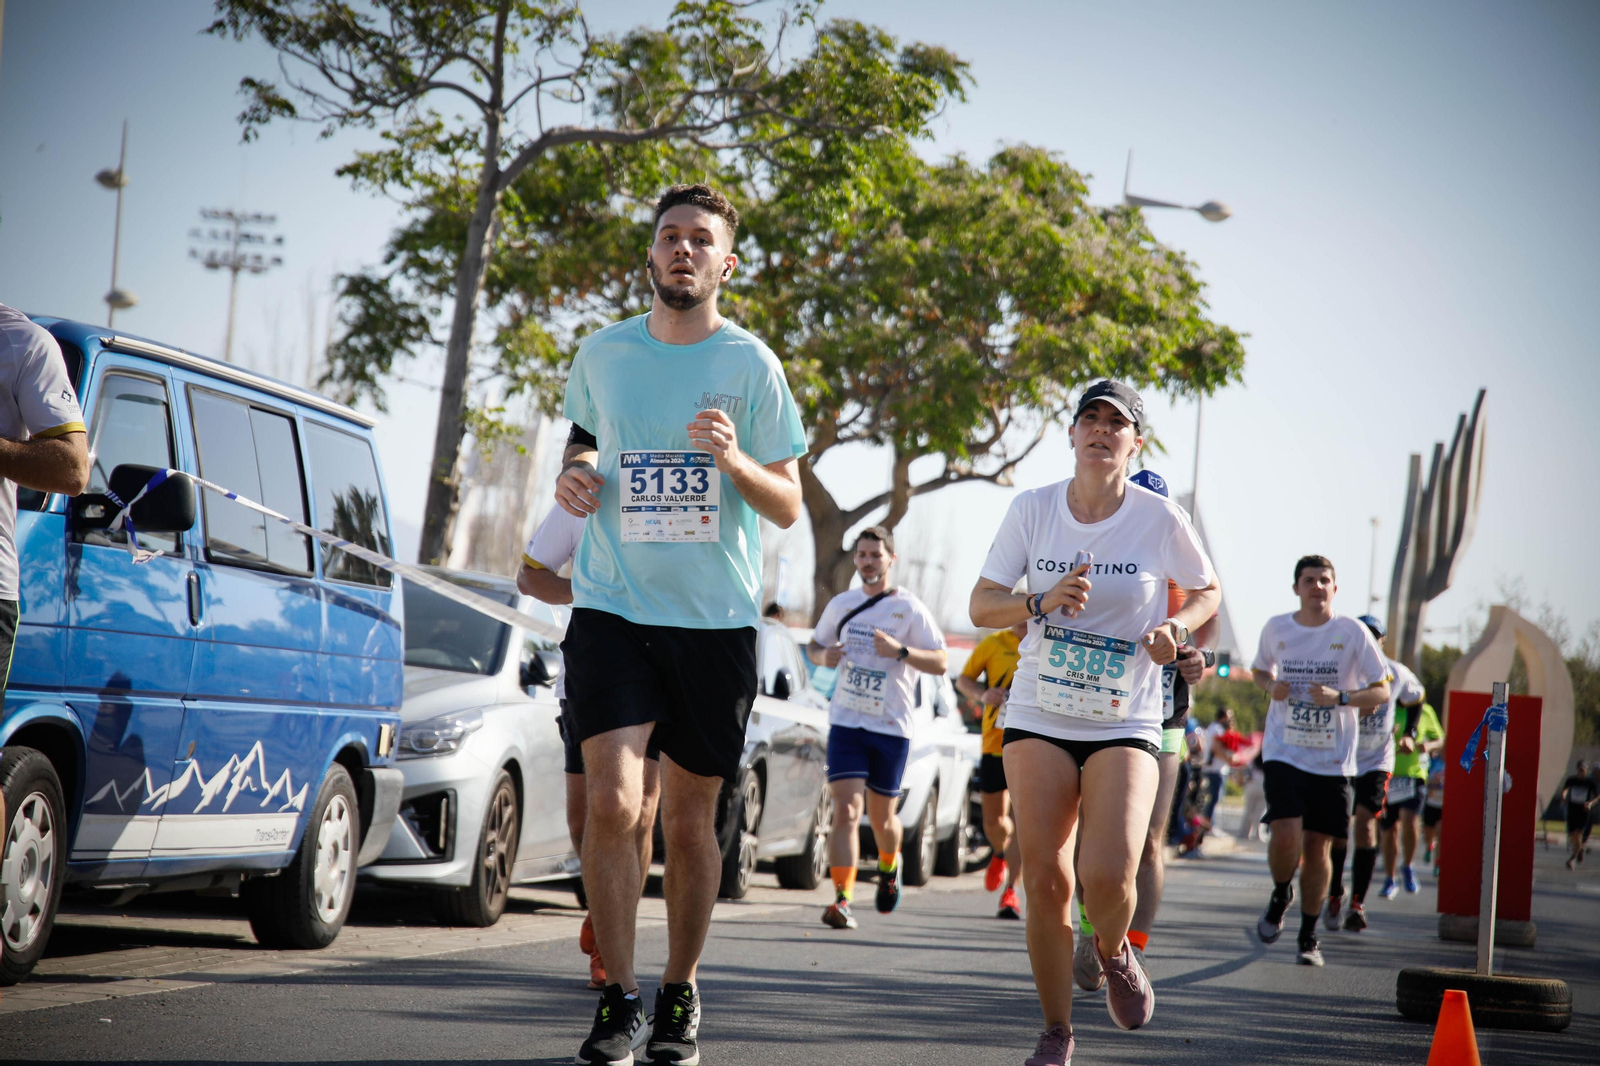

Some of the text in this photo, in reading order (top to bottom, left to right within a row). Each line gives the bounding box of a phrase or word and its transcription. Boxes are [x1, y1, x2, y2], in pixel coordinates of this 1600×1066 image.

[694, 391, 742, 413] JMFIT
[630, 468, 710, 495] 5133
[631, 494, 707, 503] CARLOS VALVERDE
[1036, 558, 1138, 575] COSTINO
[1091, 639, 1107, 647] 2024
[1048, 640, 1126, 679] 5385
[1306, 659, 1339, 667] Maratón
[846, 670, 882, 692] 5812
[1066, 670, 1100, 683] CRIS MM
[1291, 706, 1332, 724] 5419
[1359, 715, 1384, 728] 452
